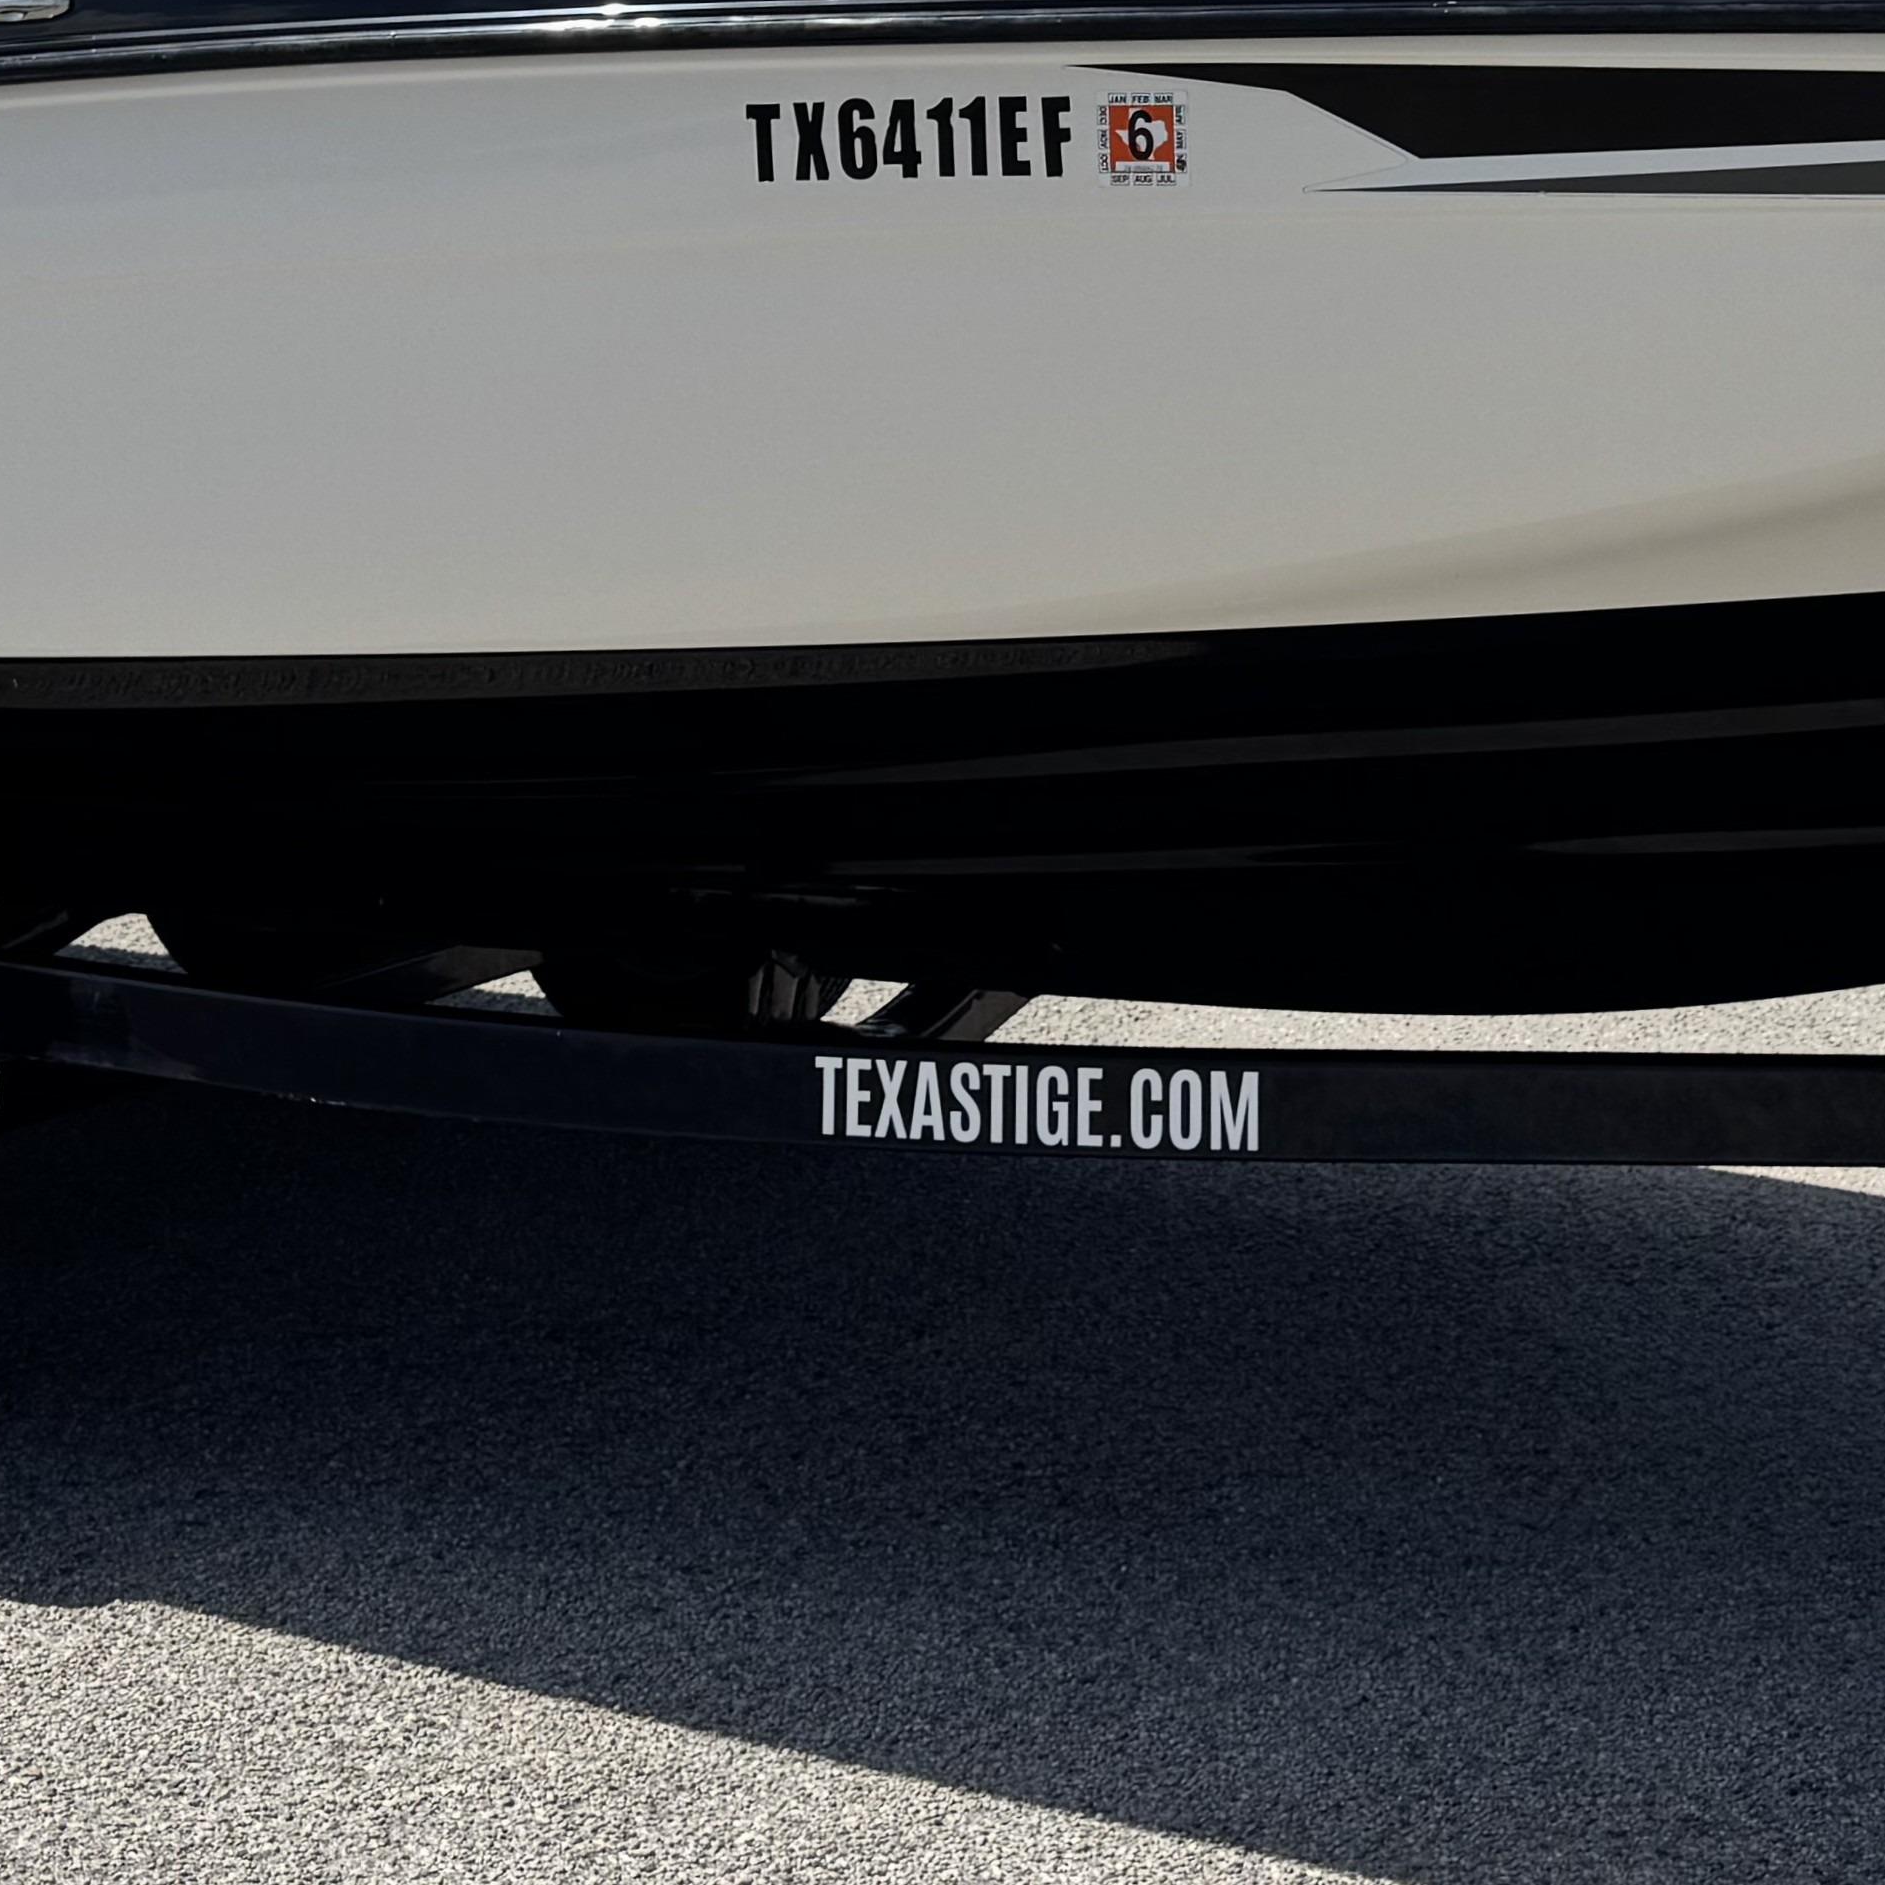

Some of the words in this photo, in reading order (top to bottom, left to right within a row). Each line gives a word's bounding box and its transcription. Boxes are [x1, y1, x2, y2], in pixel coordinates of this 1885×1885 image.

[1131, 95, 1150, 104] FEB
[745, 95, 1072, 183] TX6411EF
[1128, 110, 1154, 161] 6
[1134, 175, 1153, 183] AUG
[814, 1055, 1260, 1153] TEXASTIGE.COM
